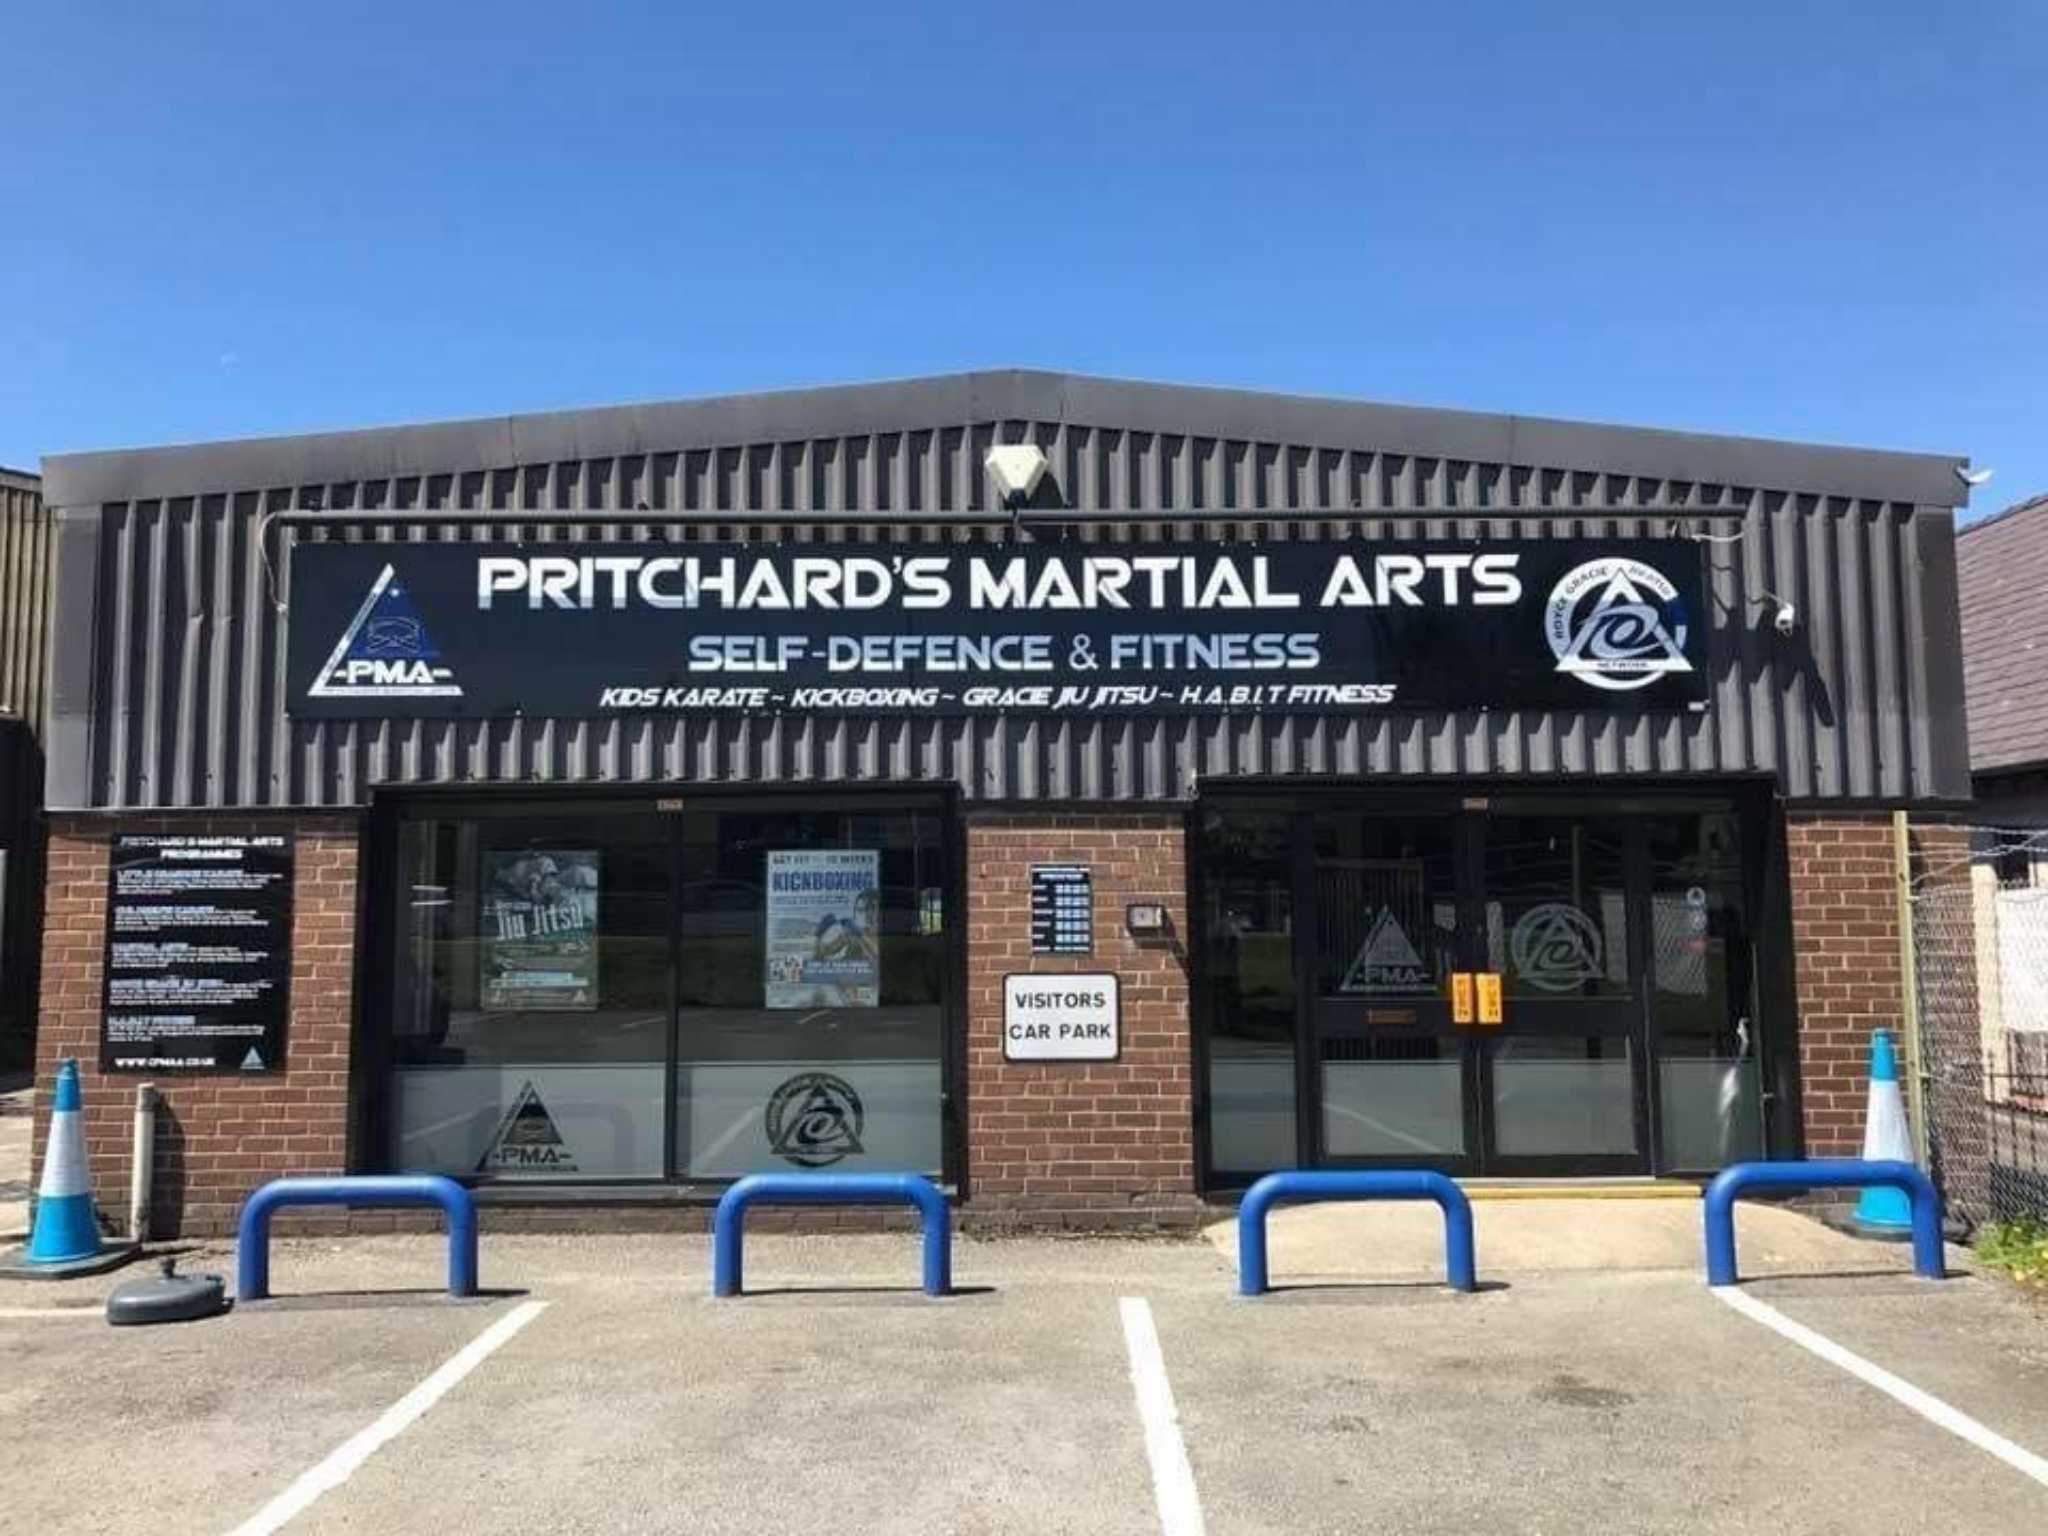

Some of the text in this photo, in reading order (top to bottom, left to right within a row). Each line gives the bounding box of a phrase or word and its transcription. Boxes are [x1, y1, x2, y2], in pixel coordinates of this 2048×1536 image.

[477, 553, 1523, 609] PRITCHARD'S MARTIAL ARTS
[688, 633, 1321, 673] SELF-DEFENCE & FITNESS
[600, 687, 662, 708] KIDS
[661, 687, 770, 708] KARATE
[790, 686, 940, 708] KICKBOXING
[962, 686, 1054, 707] GRACIE
[1051, 686, 1090, 711] JIU
[1088, 685, 1159, 710] JITSU
[1286, 683, 1398, 705] FITNESS
[773, 871, 874, 892] KICKBOXING
[1015, 992, 1107, 1009] VISITORS
[1009, 1023, 1111, 1040] CAR PARK
